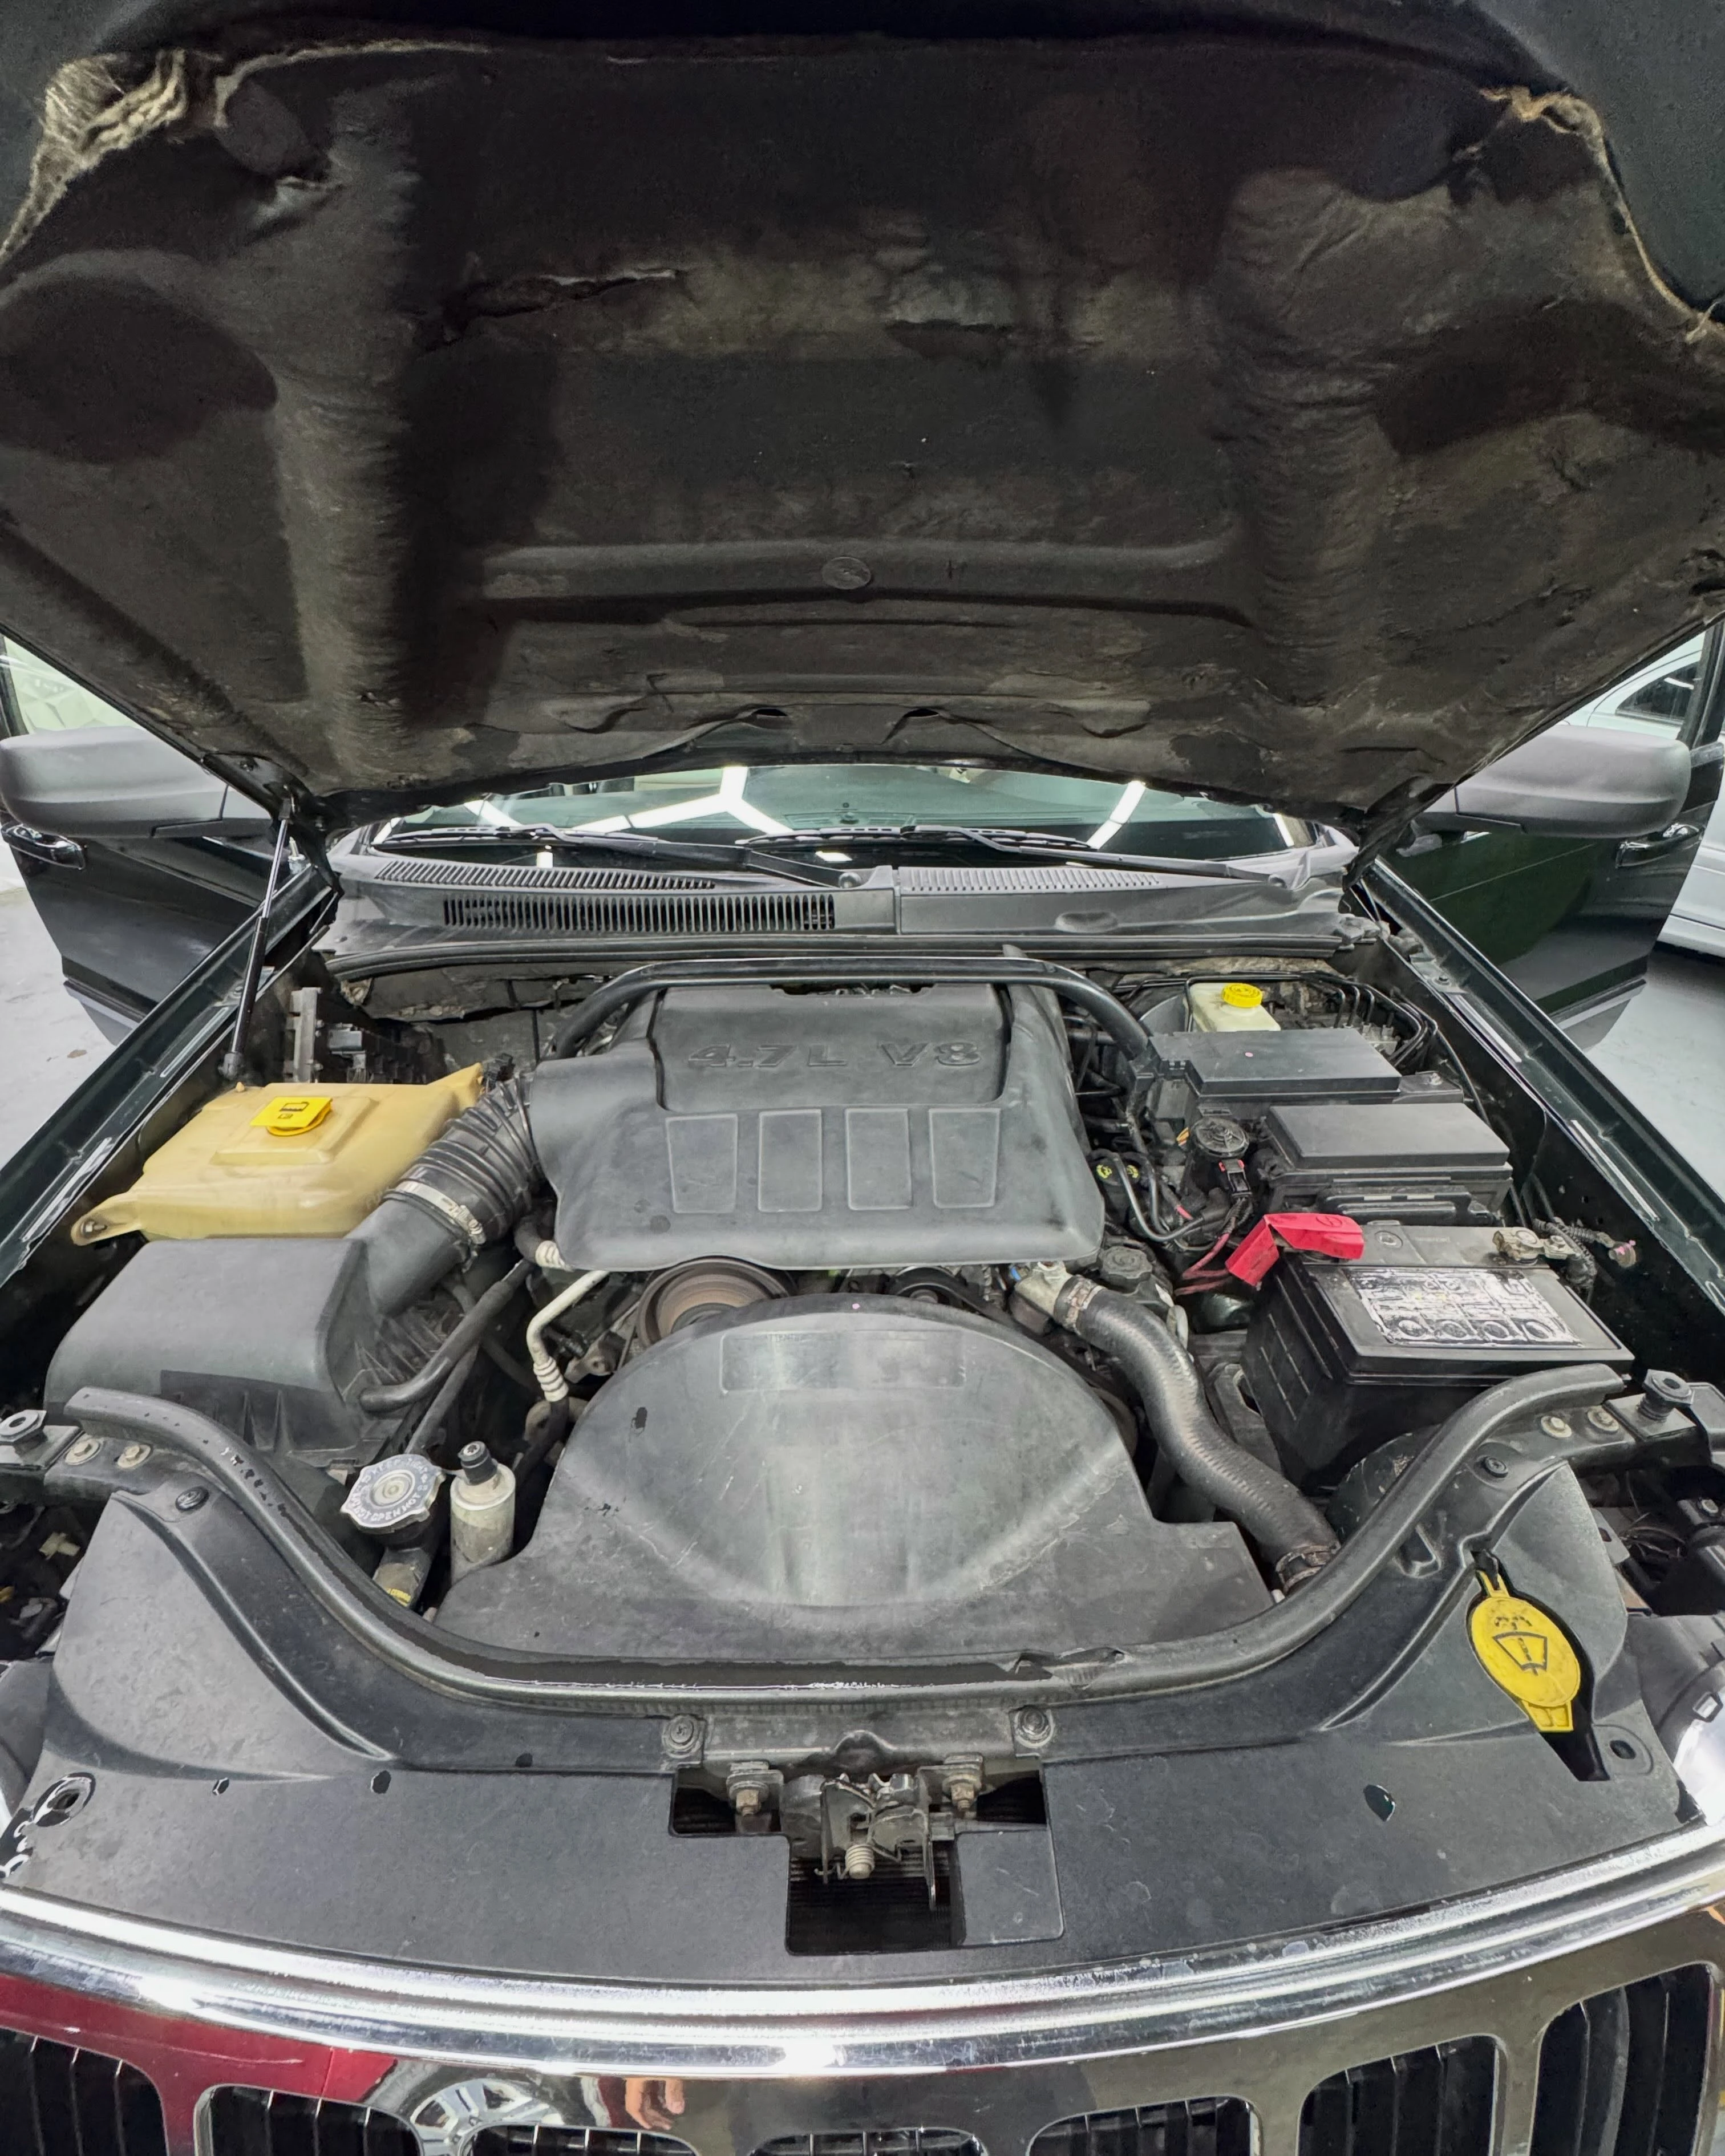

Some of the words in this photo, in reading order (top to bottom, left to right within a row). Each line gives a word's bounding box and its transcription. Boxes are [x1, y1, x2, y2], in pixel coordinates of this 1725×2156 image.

[688, 1044, 848, 1067] 4.7L
[878, 1041, 982, 1066] V8
[371, 1509, 402, 1521] OPEN
[401, 1492, 421, 1512] HOT
